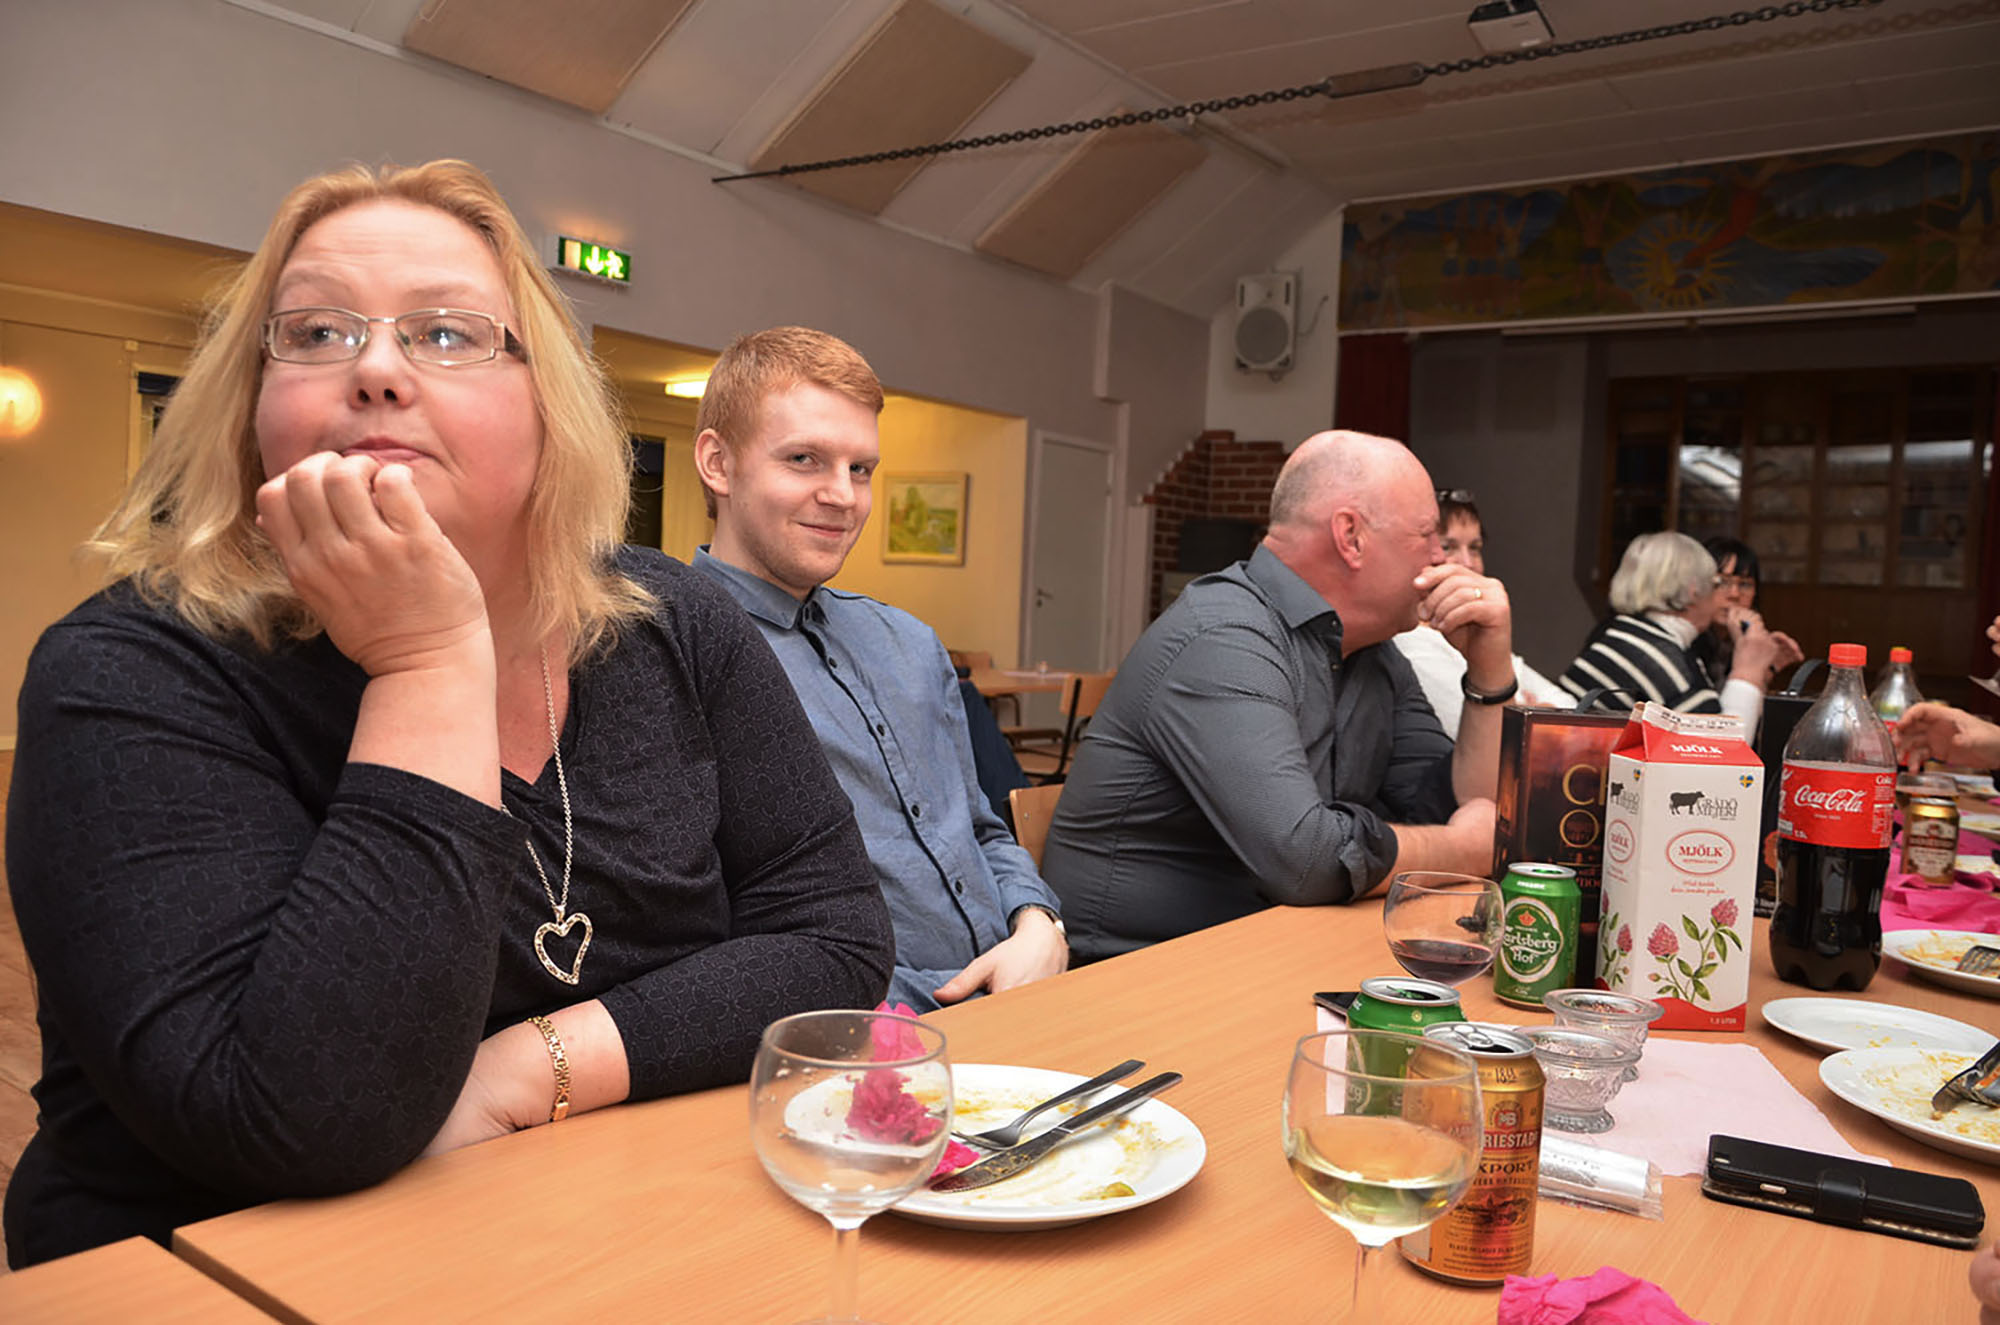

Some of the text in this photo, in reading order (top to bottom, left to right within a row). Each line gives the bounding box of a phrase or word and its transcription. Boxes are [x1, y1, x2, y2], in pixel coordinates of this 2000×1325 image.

[1794, 784, 1867, 813] Coca-Cola
[1679, 844, 1723, 857] MJÖLK
[1503, 932, 1557, 954] arlsberg
[1483, 1131, 1539, 1148] RIESTAD
[1478, 1161, 1535, 1175] XPORT
